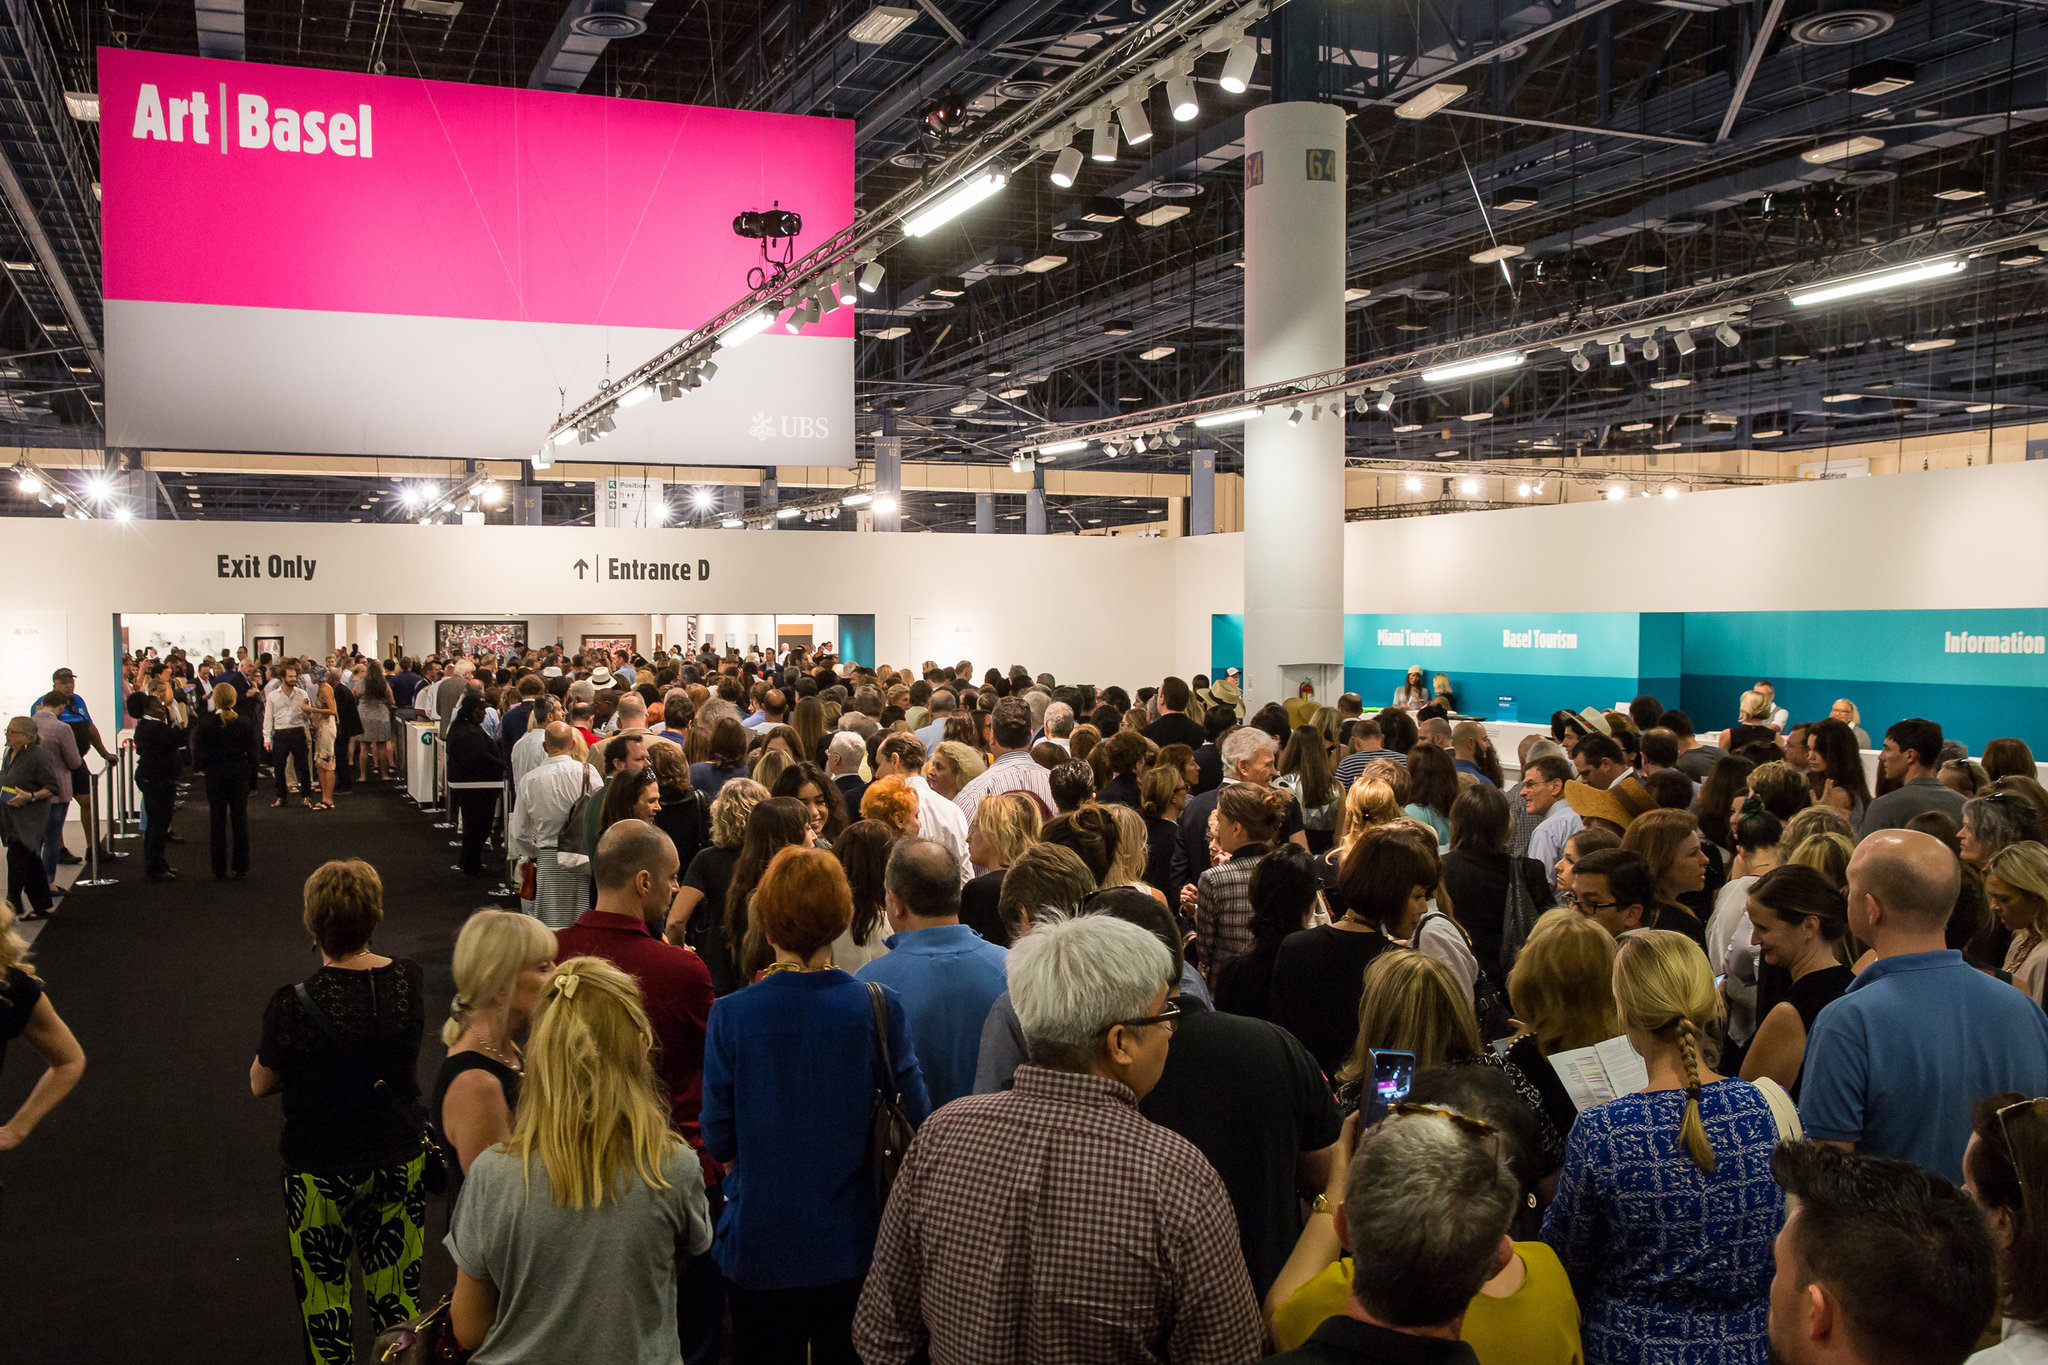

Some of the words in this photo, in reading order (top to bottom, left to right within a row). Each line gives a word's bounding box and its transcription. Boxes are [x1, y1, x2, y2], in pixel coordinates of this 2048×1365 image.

[131, 83, 210, 145] Art
[237, 93, 374, 158] Basel
[1309, 150, 1335, 182] 64
[780, 415, 829, 439] UBS
[217, 554, 261, 578] Exit
[267, 554, 317, 581] Only
[608, 557, 691, 581] Entrance
[698, 559, 710, 581] D
[1377, 628, 1404, 646] Miami
[1405, 628, 1442, 647] Tourism
[1503, 629, 1532, 648] Basel
[1533, 629, 1578, 649] Tourism
[1944, 631, 2046, 655] Information
